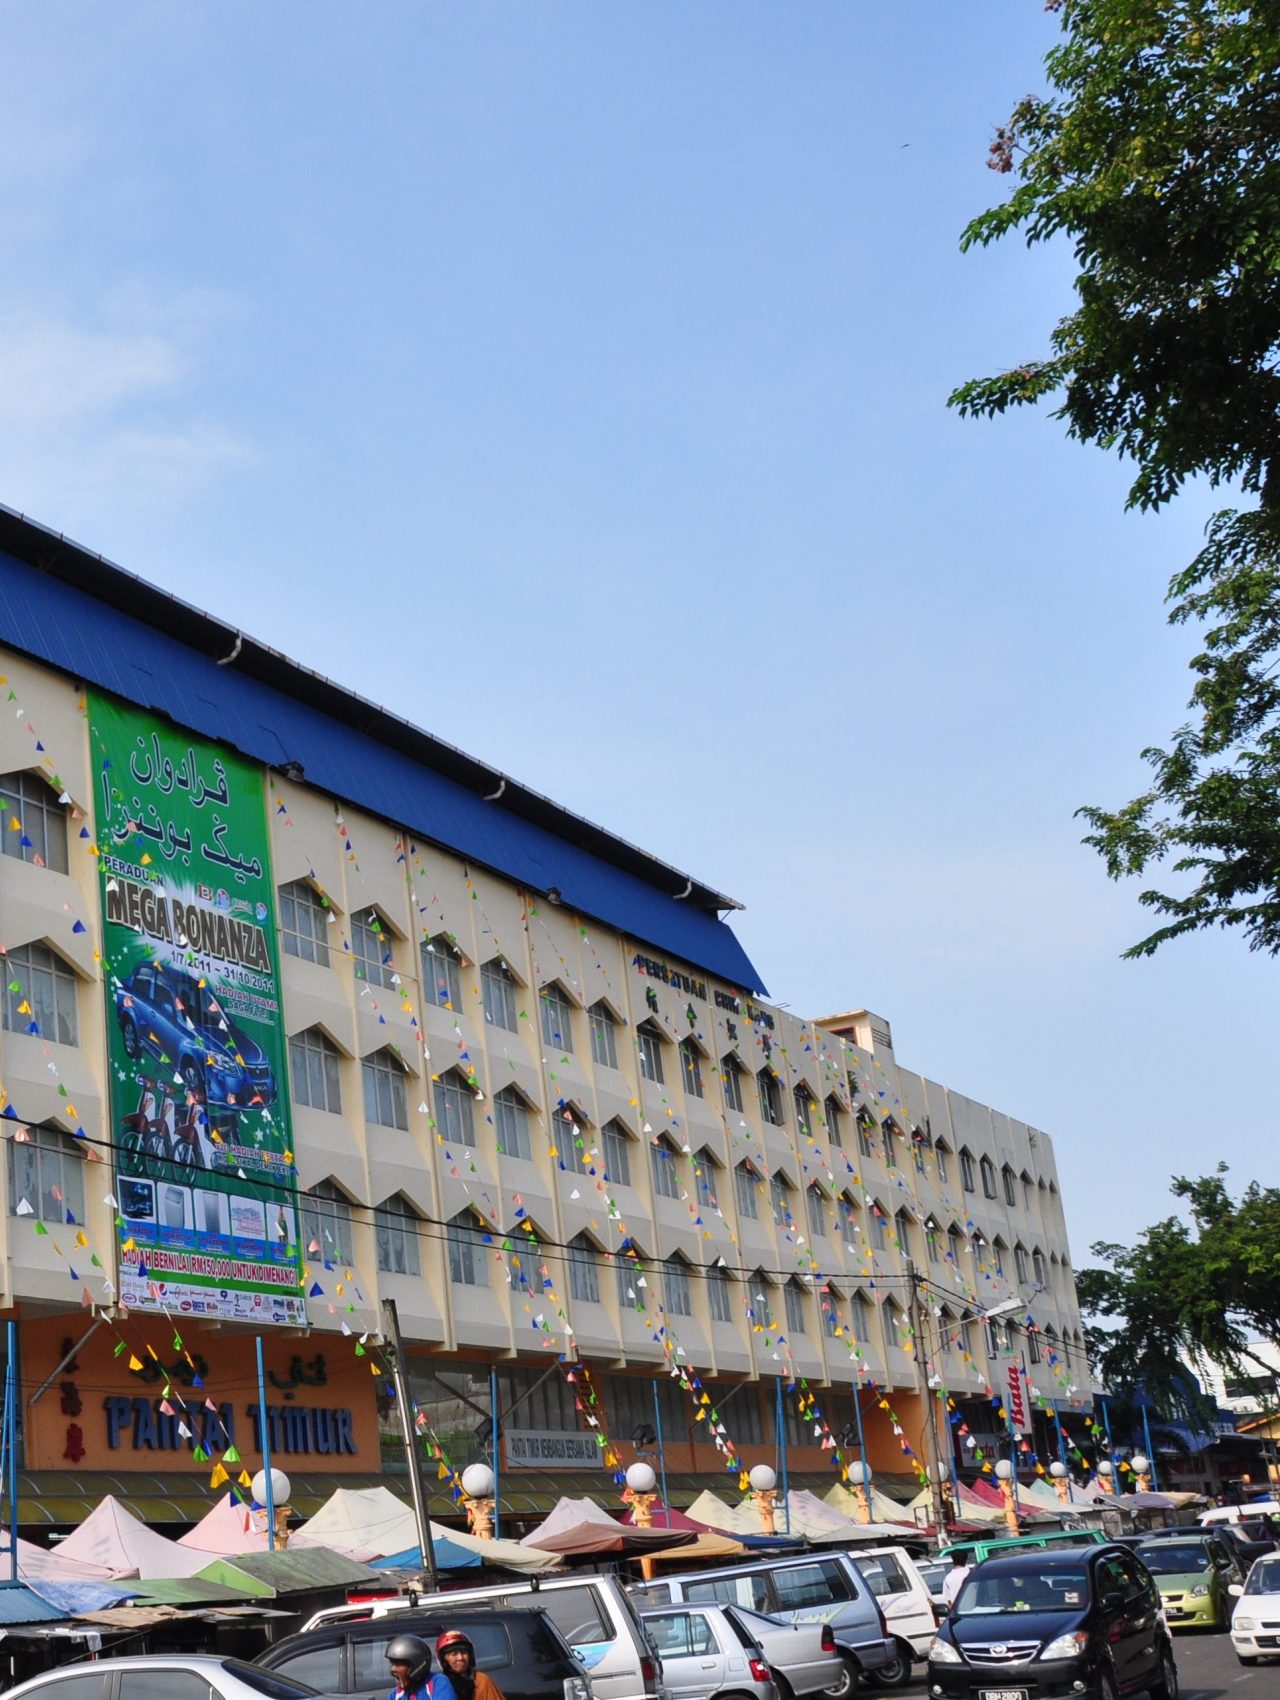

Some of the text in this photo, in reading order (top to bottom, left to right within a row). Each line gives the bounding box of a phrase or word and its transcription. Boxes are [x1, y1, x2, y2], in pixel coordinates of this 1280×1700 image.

[106, 871, 271, 973] MEGA BONANZA
[224, 967, 275, 993] 31/10/2011
[122, 1250, 151, 1271] HADIAH
[153, 1251, 191, 1274] BERNILAI
[232, 1261, 257, 1281] UNTUK
[105, 1395, 235, 1450] PANTAI
[248, 1403, 357, 1454] TIMUR
[1007, 1365, 1025, 1428] Bata
